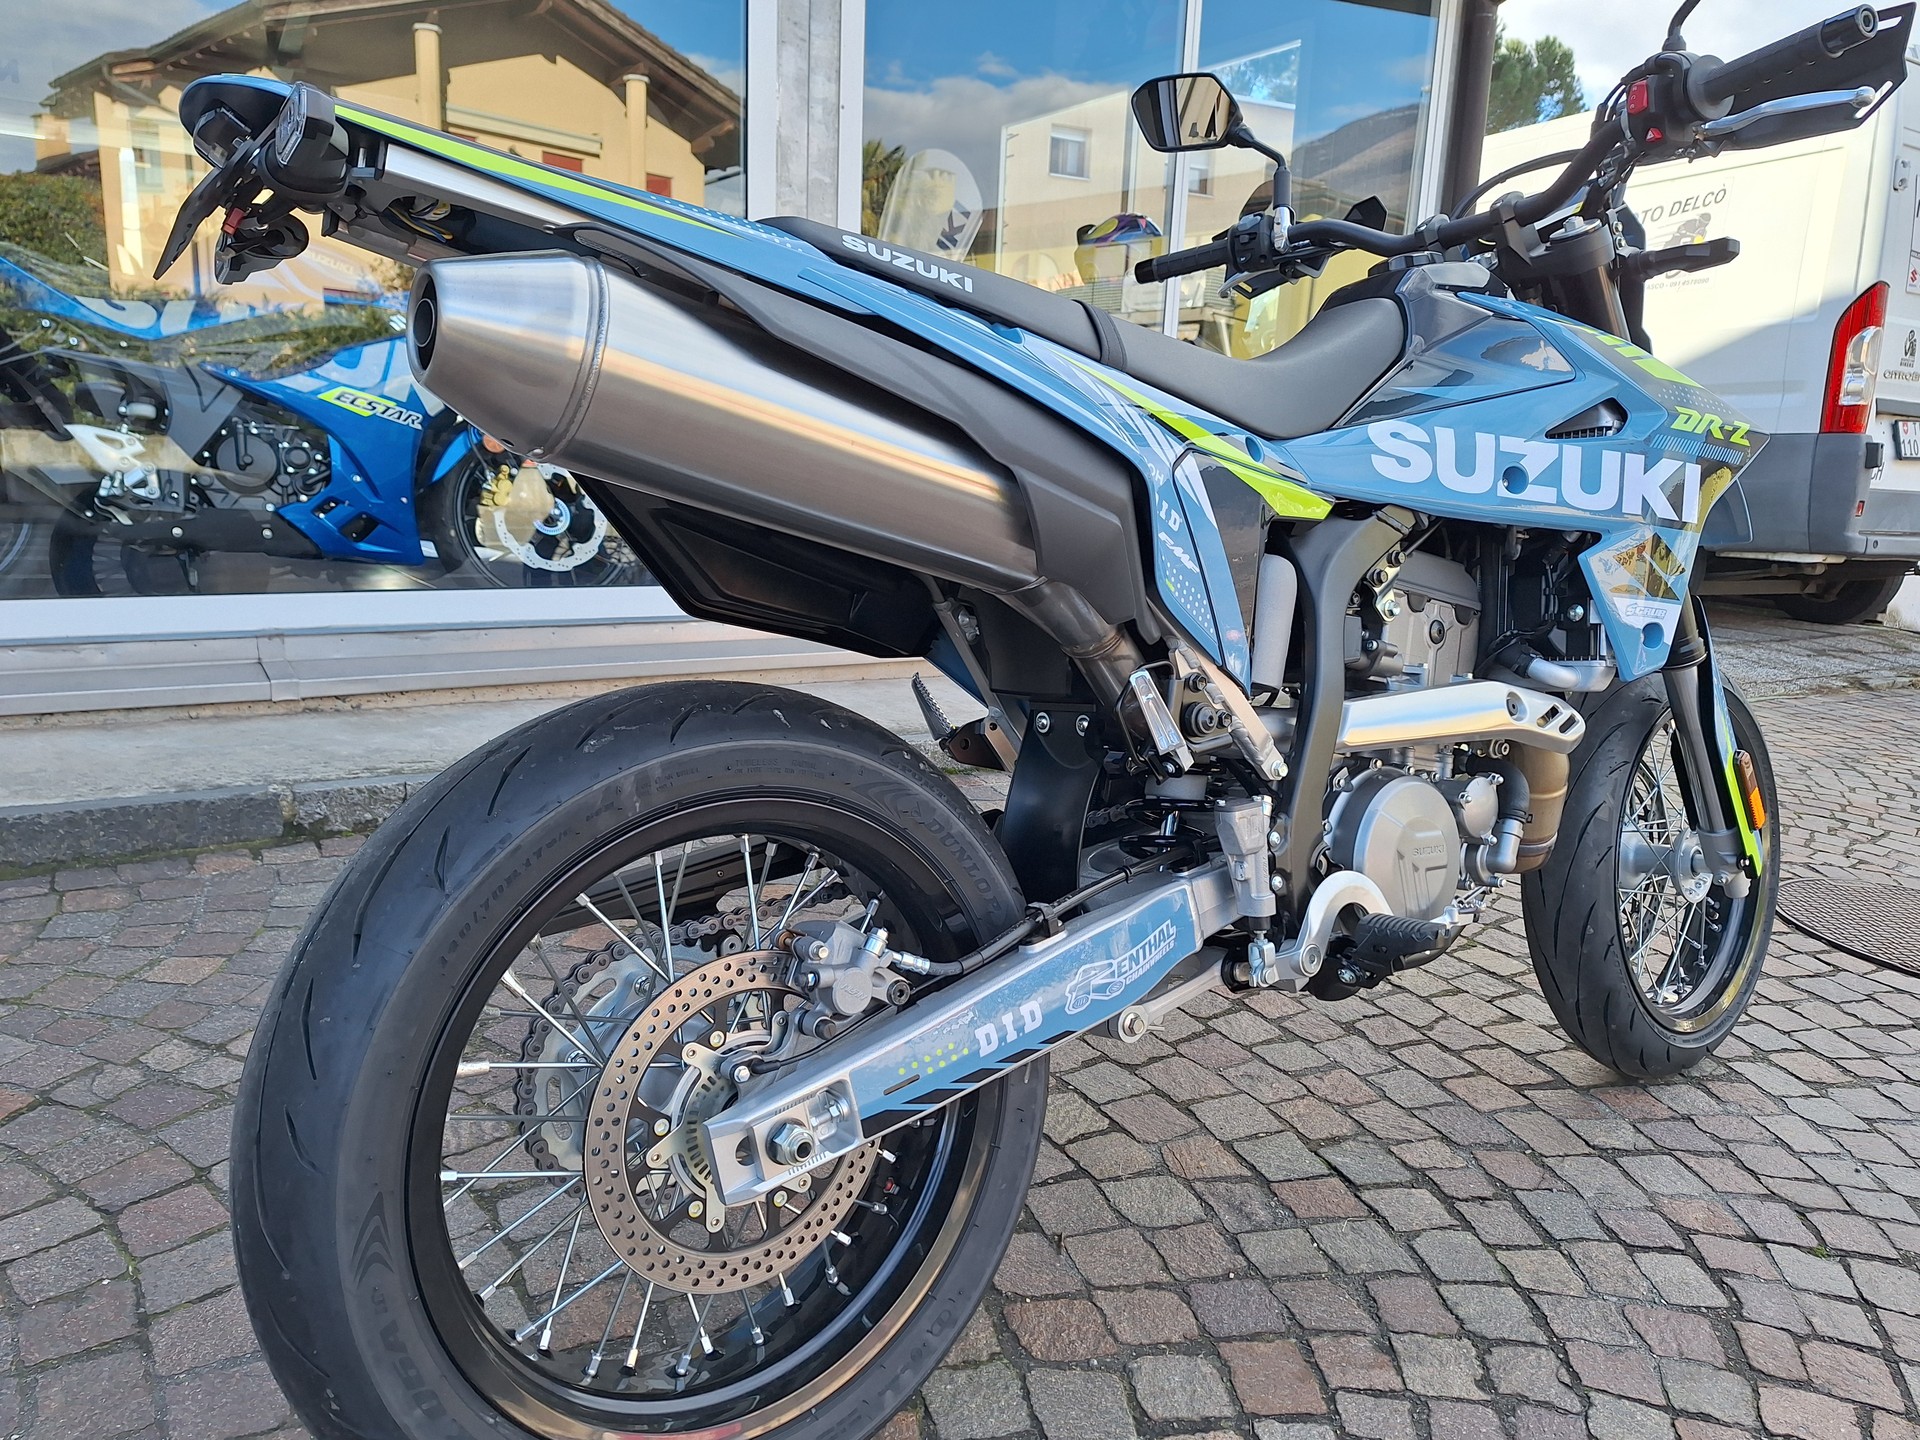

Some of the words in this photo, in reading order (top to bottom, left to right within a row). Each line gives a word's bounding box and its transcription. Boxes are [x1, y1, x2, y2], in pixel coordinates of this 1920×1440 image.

[1668, 183, 1727, 218] DELCÒ
[841, 234, 973, 293] SUZUKI
[334, 389, 424, 430] ECSTAR
[1670, 405, 1751, 447] DR-Z
[1367, 420, 1702, 524] SUZUKI
[1158, 531, 1200, 574] FMF
[1412, 844, 1445, 857] SUZUKI
[1065, 919, 1177, 1015] RENTHAL
[974, 999, 1044, 1058] D.I.D
